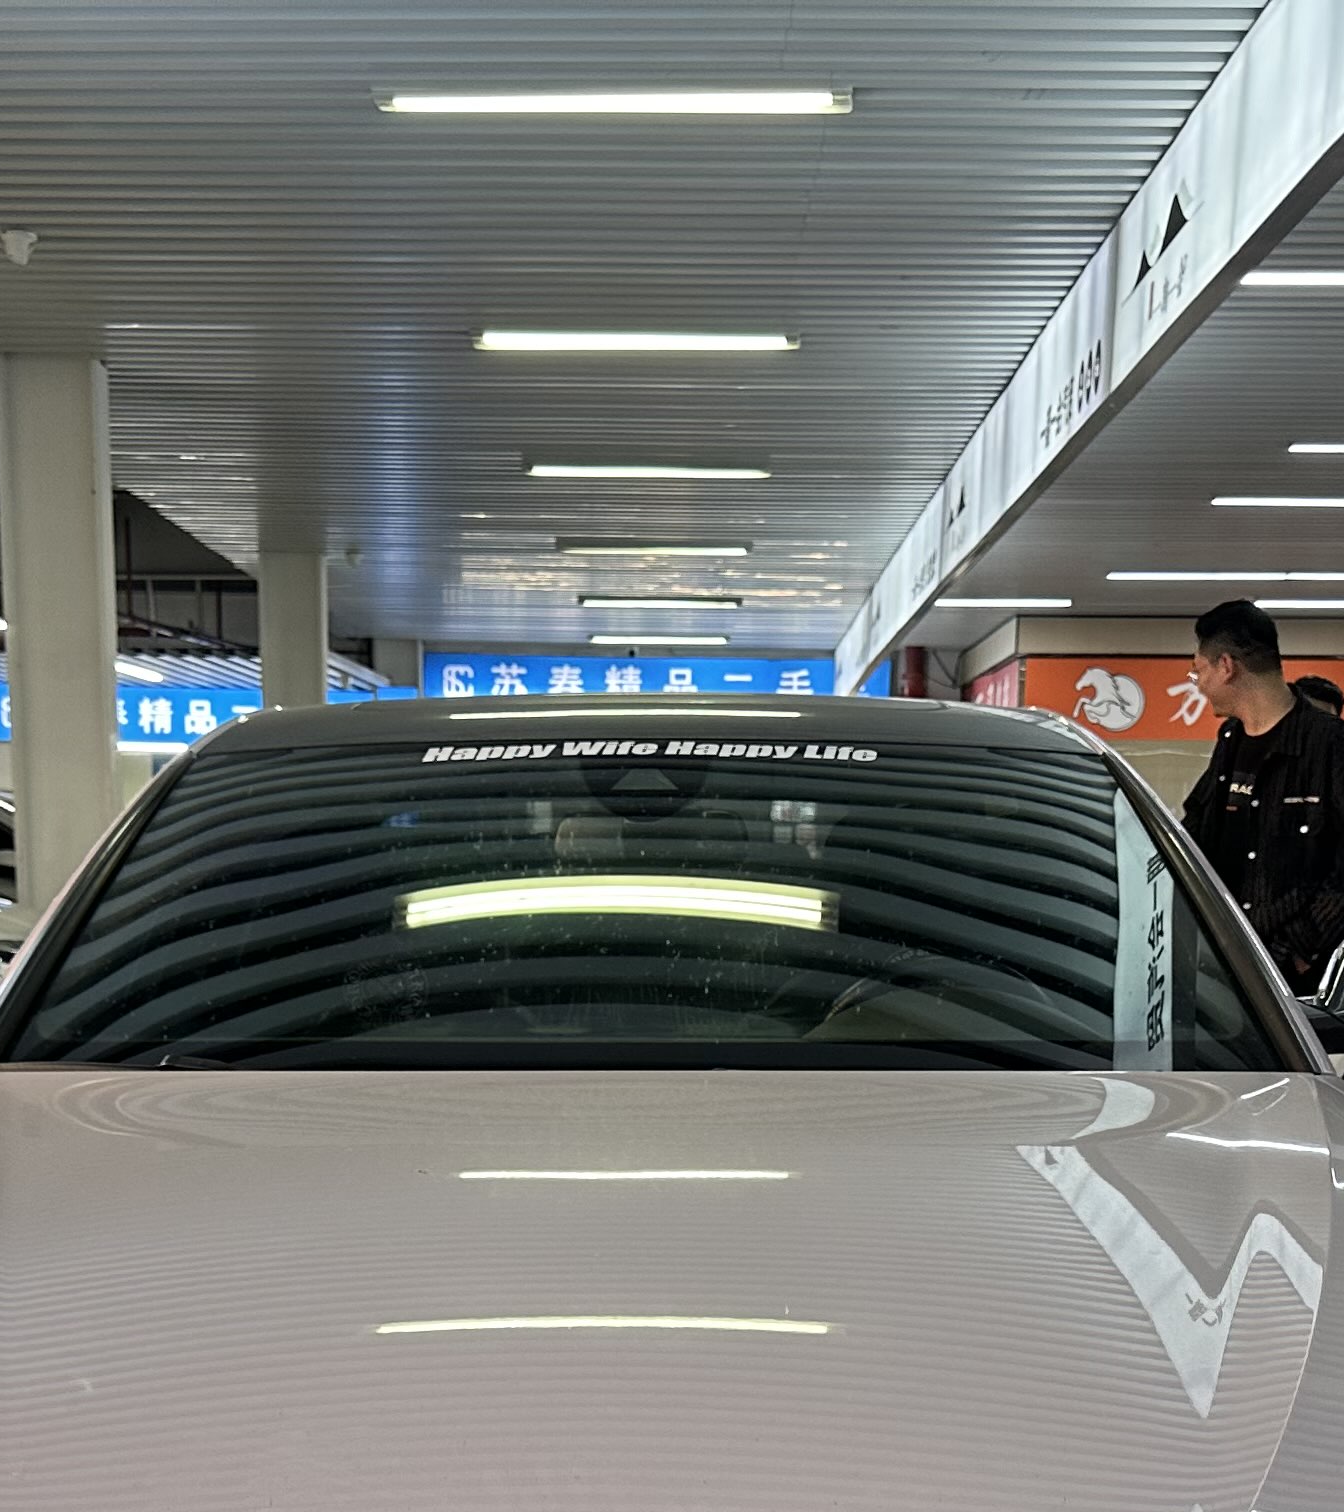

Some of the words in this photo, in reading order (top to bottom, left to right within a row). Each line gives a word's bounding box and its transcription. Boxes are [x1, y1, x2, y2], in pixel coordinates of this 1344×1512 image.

[422, 744, 556, 763] Happy
[561, 740, 658, 756] Wife
[663, 741, 798, 760] Happy
[803, 744, 878, 763] Life
